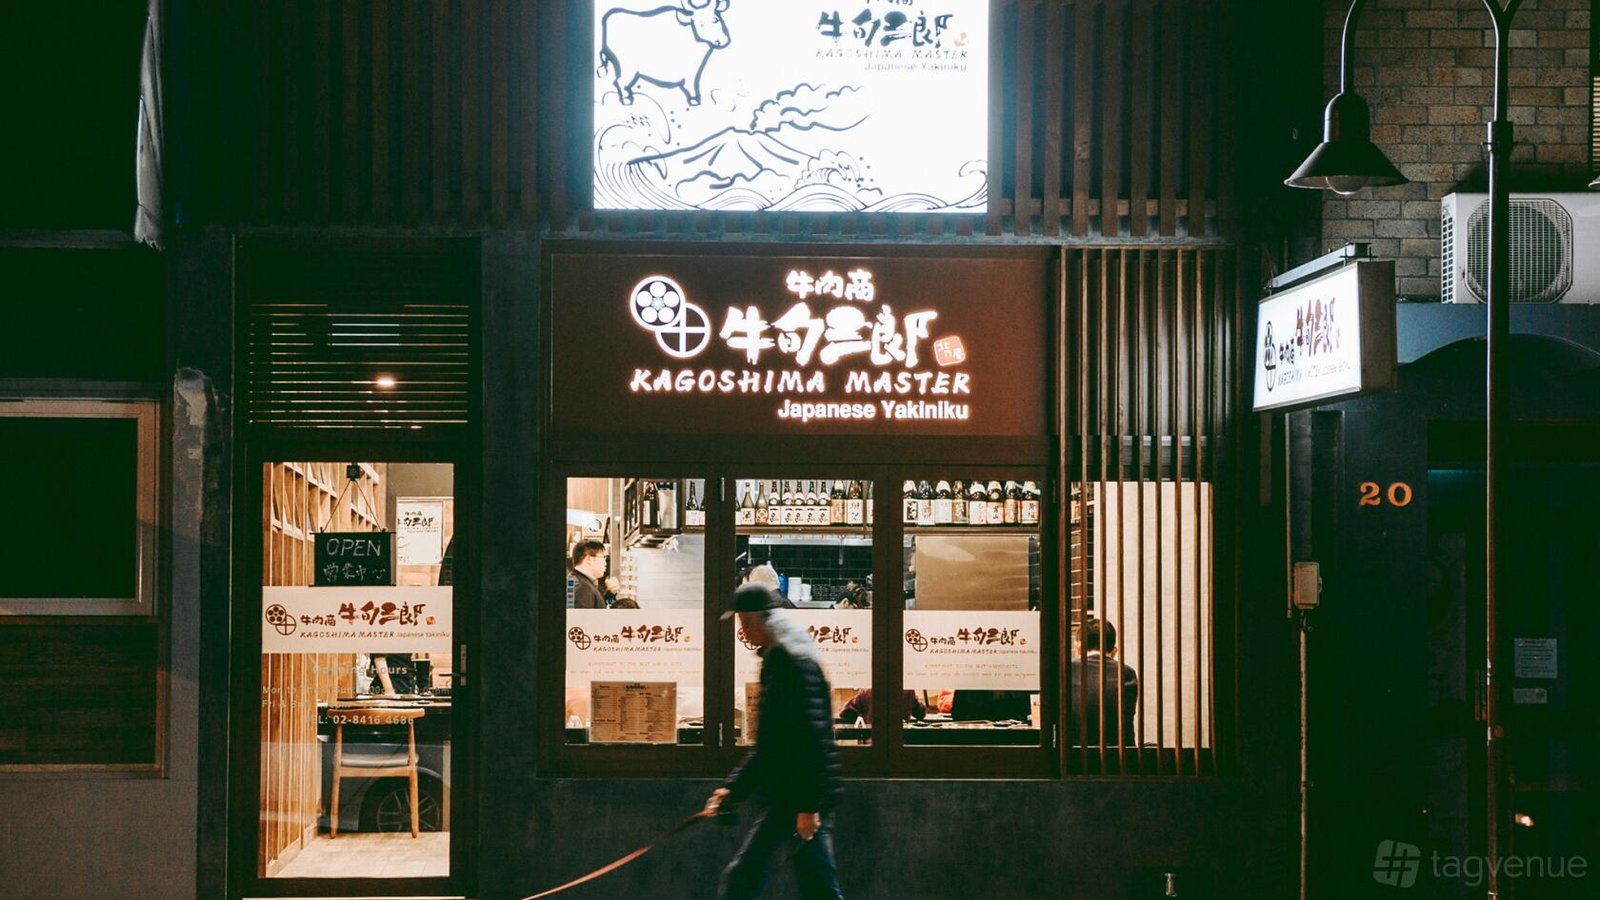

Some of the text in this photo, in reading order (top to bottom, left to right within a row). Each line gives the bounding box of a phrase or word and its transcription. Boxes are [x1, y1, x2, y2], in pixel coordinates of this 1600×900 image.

[815, 49, 968, 58] KAGOSHIMA MASTER
[864, 62, 968, 71] Japanese Yakiniku
[630, 369, 971, 394] KAGOSHIMA MASTER
[778, 400, 969, 422] Japanese Yakiniku
[1359, 481, 1413, 507] 20
[326, 538, 381, 556] OPEN
[371, 665, 408, 675] Hours
[332, 715, 380, 725] 02-8416
[386, 715, 414, 725] 4686
